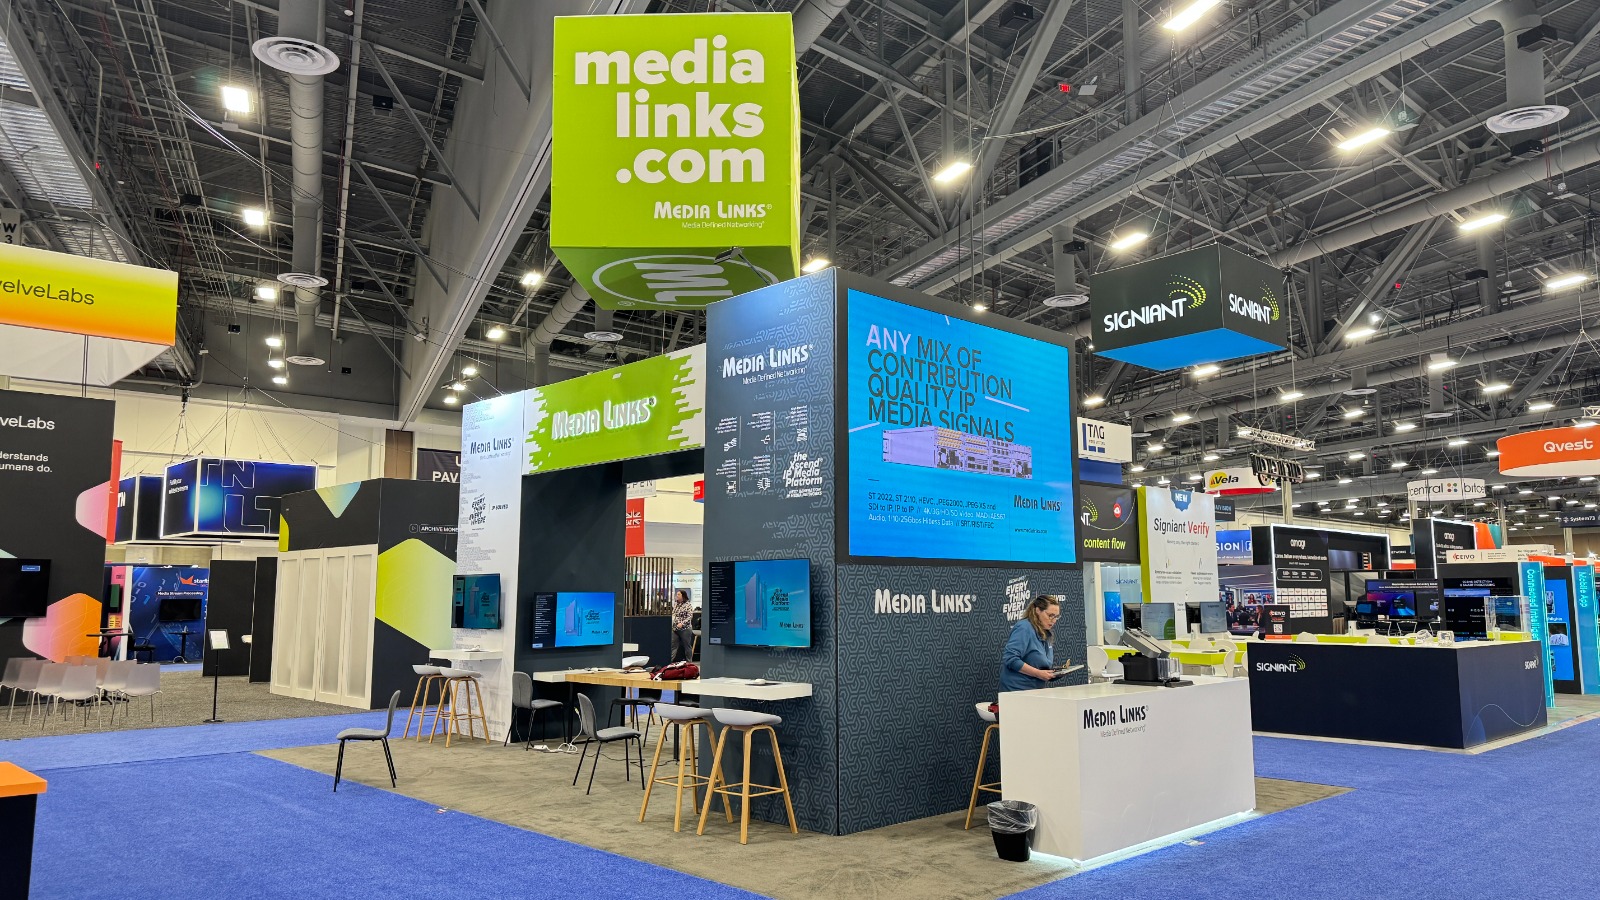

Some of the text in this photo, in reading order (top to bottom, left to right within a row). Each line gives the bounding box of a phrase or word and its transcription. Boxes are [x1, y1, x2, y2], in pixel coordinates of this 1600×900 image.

[574, 34, 765, 85] media
[616, 88, 765, 138] links
[616, 148, 765, 184] .com
[653, 201, 711, 219] MEDIA
[3, 222, 17, 233] W
[681, 221, 701, 229] Media
[701, 221, 727, 229] Defined
[0, 279, 95, 305] elveLabs
[1103, 297, 1188, 333] SIGNIANT
[1228, 293, 1273, 325] SIGNIANT
[866, 323, 982, 371] ANY MIX OF
[722, 355, 765, 379] MEDIA
[867, 349, 1012, 400] CONTRIBUTION
[867, 373, 976, 413] QUALITY IP
[551, 409, 600, 440] MEDIA
[868, 397, 1015, 442] MEDIA SIGNALS
[1087, 423, 1105, 439] TAG
[470, 441, 491, 455] MEDIA
[1543, 438, 1594, 453] Qvest
[794, 452, 808, 461] the
[36, 464, 53, 473] do.
[793, 467, 821, 479] Media
[785, 476, 823, 488] Platform
[1213, 475, 1239, 484] Vela
[868, 492, 877, 500] ST
[895, 494, 903, 503] ST
[1174, 493, 1188, 503] NEW
[1569, 515, 1596, 523] System73
[1153, 517, 1210, 539] Signiant Verify
[1083, 536, 1126, 550] content flow
[1005, 580, 1029, 596] EVERY
[1008, 589, 1031, 604] THING
[1578, 571, 1589, 608] Mobile App
[874, 588, 926, 614] MEDIA
[1002, 600, 1026, 614] EVERY
[1083, 708, 1116, 730] MEDIA
